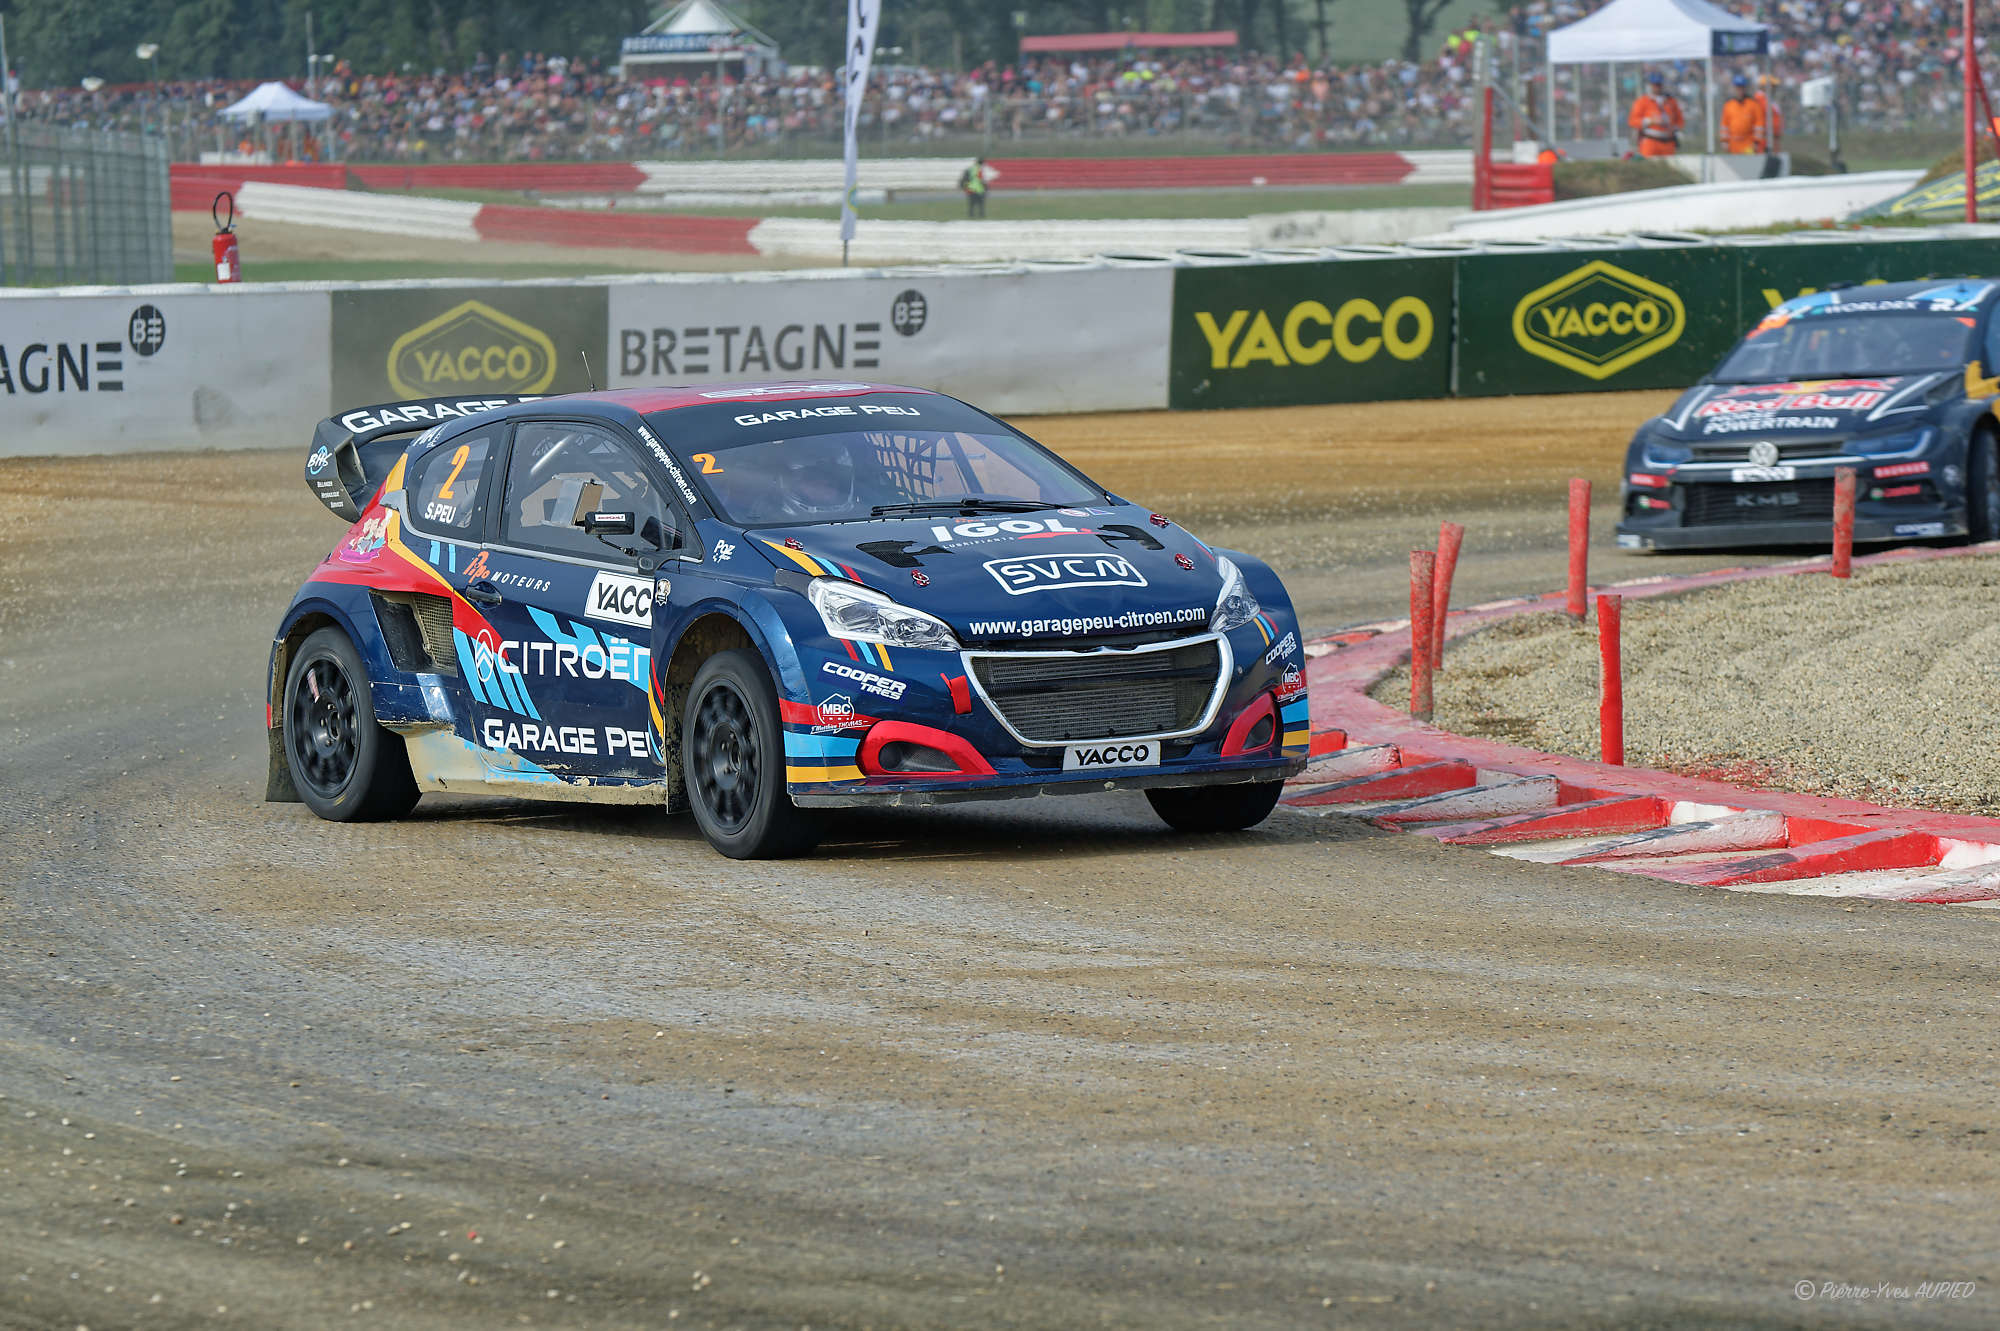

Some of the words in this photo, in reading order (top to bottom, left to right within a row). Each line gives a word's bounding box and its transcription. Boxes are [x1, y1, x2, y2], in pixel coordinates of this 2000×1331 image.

[1195, 295, 1434, 369] YACCO
[1541, 300, 1661, 338] YACCO
[414, 345, 532, 382] YACCO
[620, 322, 881, 377] BRETAGNE
[734, 405, 857, 427] GARAGE
[859, 405, 921, 416] PEU
[1693, 394, 1790, 418] Red
[1789, 391, 1887, 410] Bull
[1703, 416, 1839, 435] POWERTRAIN
[439, 444, 471, 500] 2
[636, 425, 697, 505] www.garagepeu-citroen.com
[692, 453, 724, 475] 2
[424, 501, 457, 524] S.PEU
[930, 519, 1078, 543] IGOL
[490, 570, 551, 592] MOTEURS
[969, 606, 1206, 637] www.garagepeu-citroen.com
[1265, 631, 1295, 665] COOPER
[822, 660, 907, 694] COOPER
[860, 682, 903, 701] TIRES
[822, 703, 851, 715] MBC
[483, 718, 598, 755] GARAGE
[1075, 744, 1149, 766] YACCO
